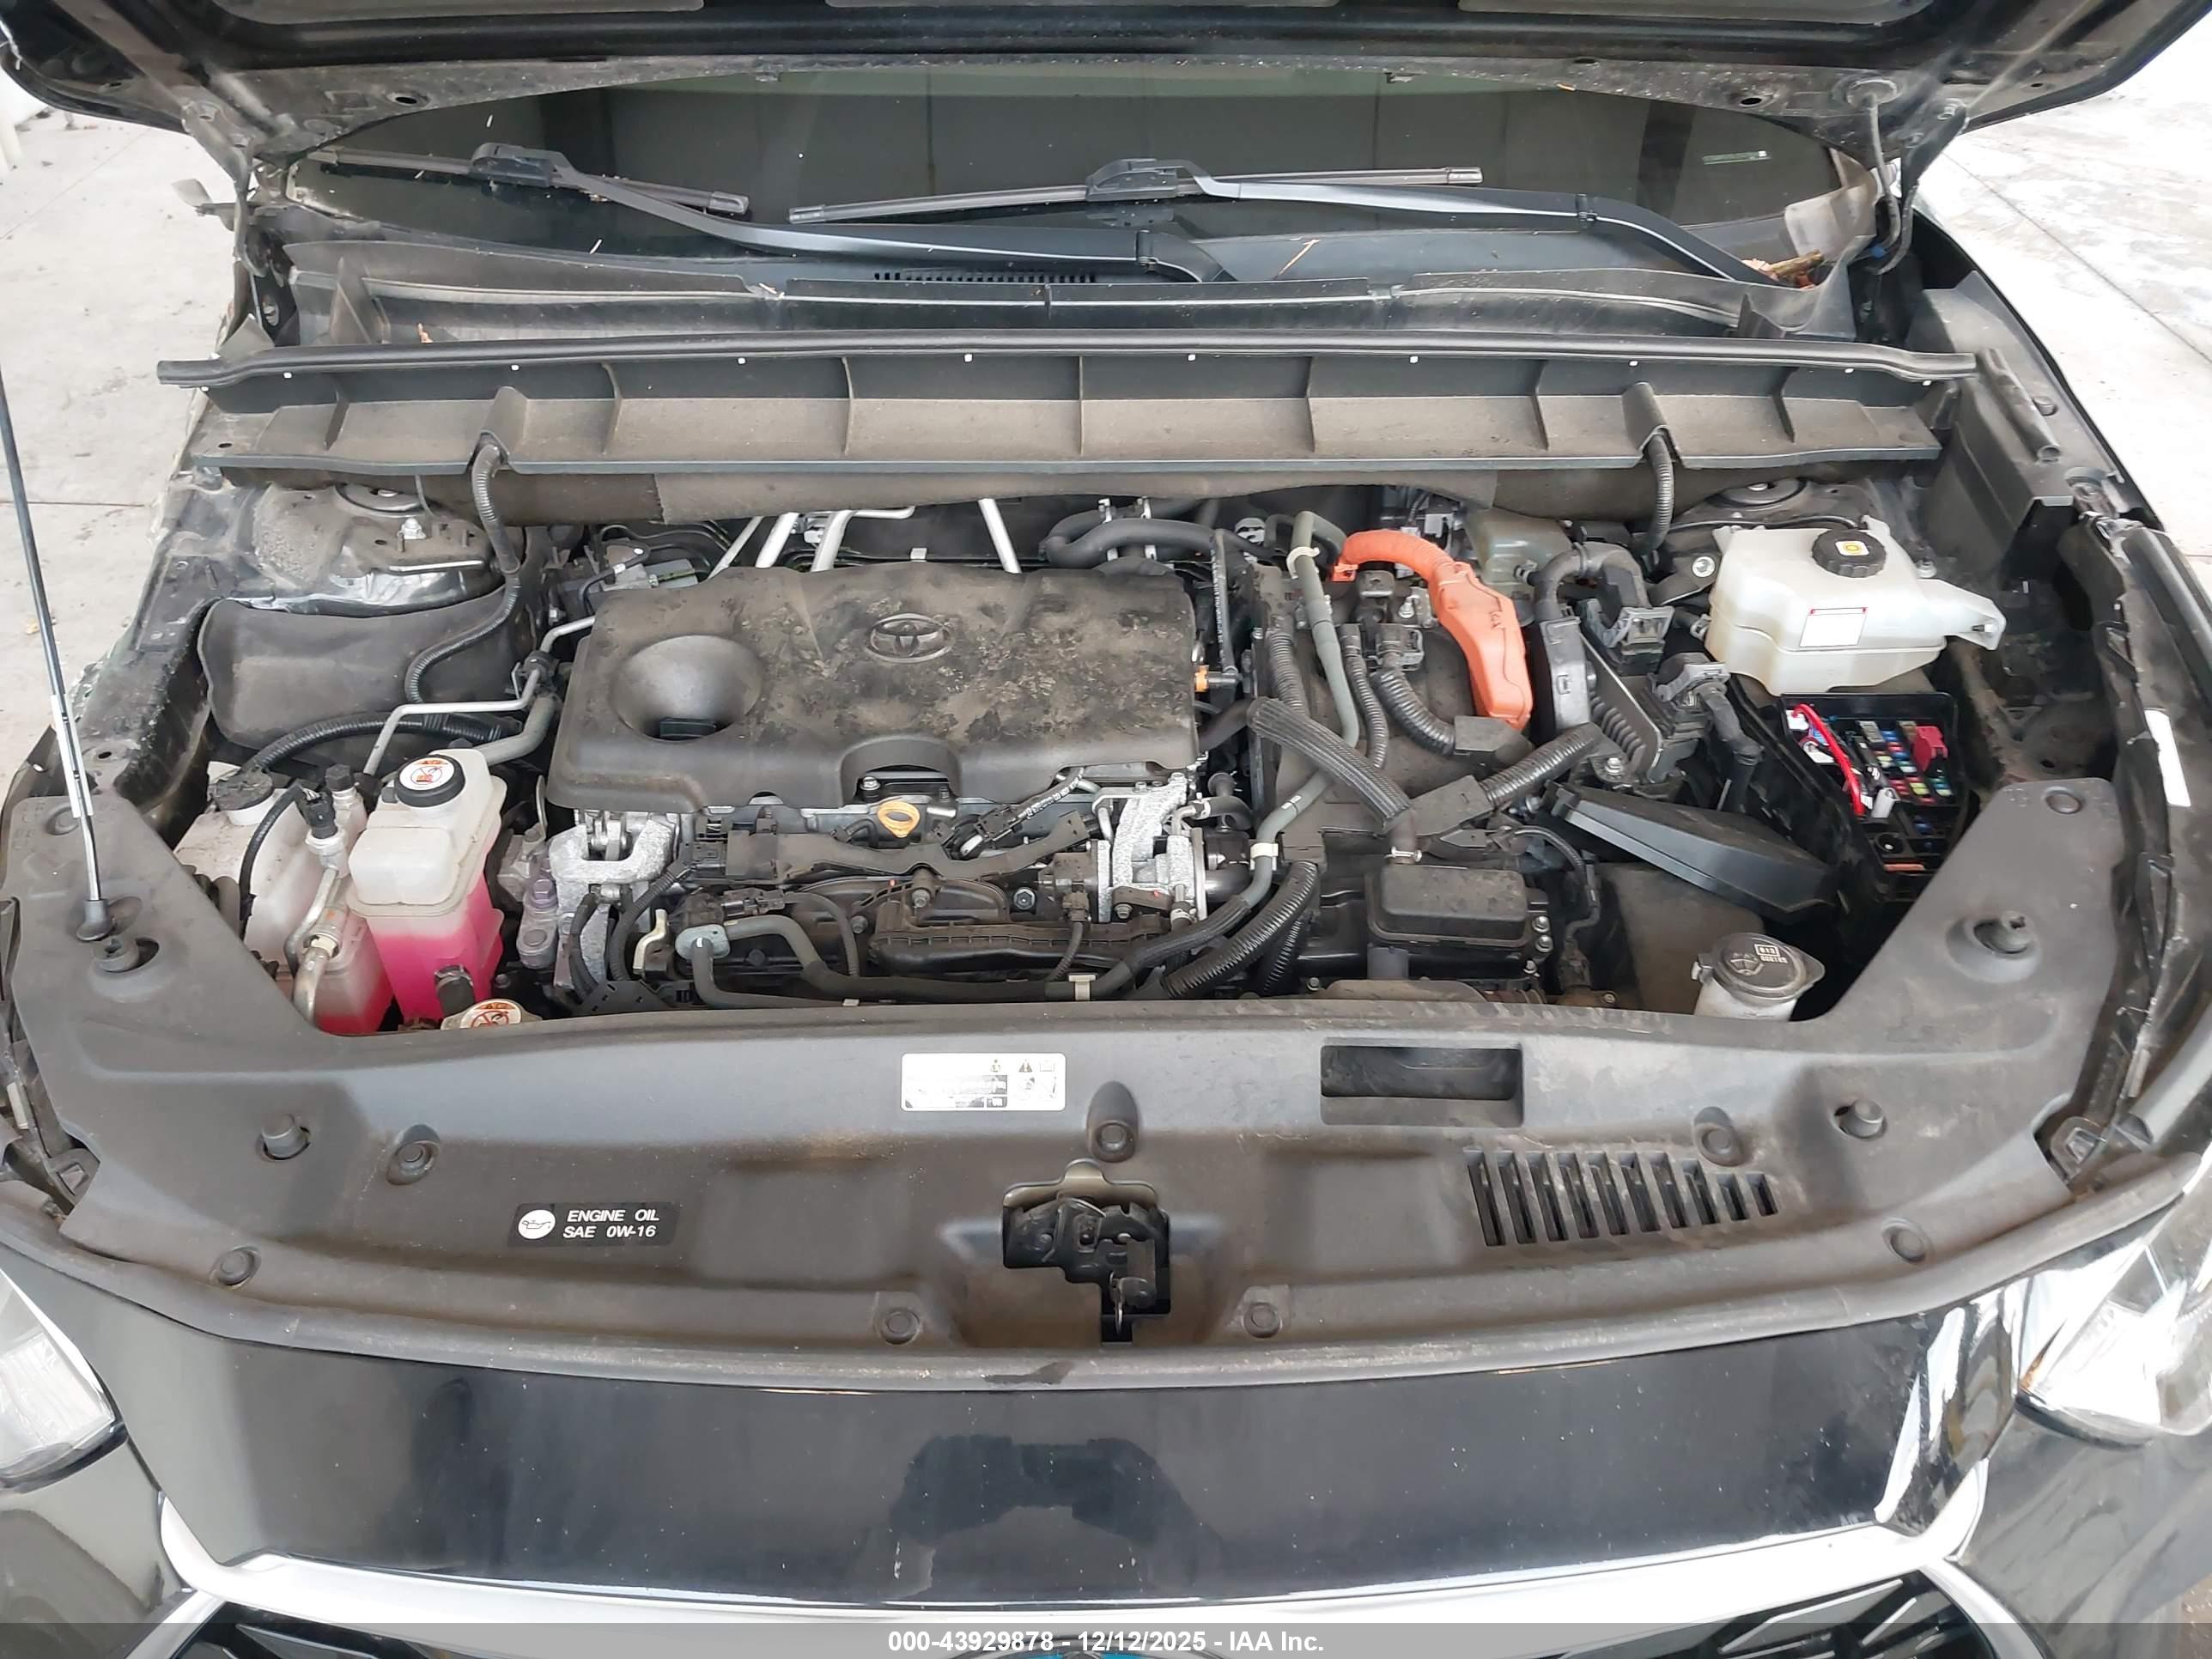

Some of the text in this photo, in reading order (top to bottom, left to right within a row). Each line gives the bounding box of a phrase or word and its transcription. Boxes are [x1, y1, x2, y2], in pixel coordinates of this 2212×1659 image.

[567, 1208, 660, 1223] ENGINE OIL
[562, 1224, 657, 1238] SAE 0W-16
